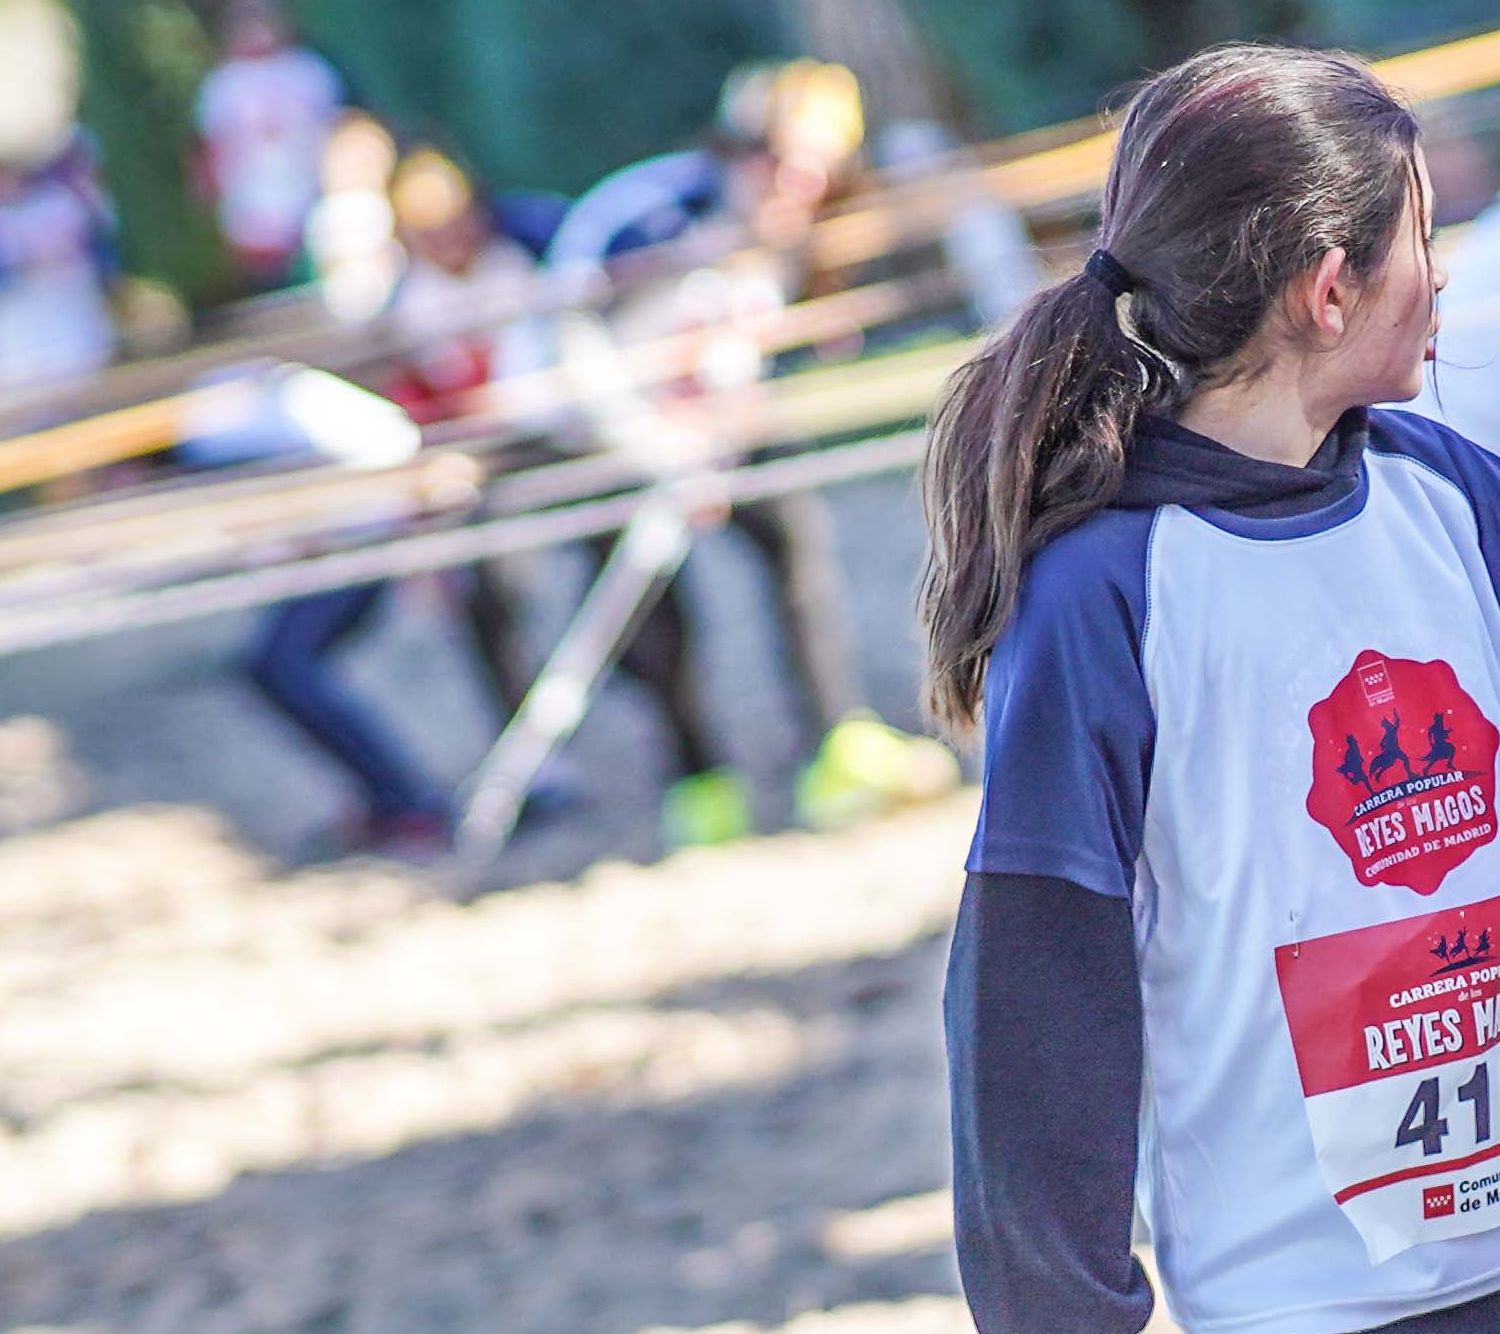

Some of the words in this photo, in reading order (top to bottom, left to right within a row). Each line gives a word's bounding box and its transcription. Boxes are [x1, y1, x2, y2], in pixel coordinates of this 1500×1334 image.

[1354, 786, 1404, 816] CARRERA
[1406, 770, 1464, 794] POPULAR
[1411, 785, 1486, 836] MAGOS
[1423, 840, 1441, 854] DE
[1444, 823, 1492, 847] MADRID
[1389, 975, 1468, 1008] CARRERA
[1364, 1008, 1464, 1071] REYES
[1460, 1198, 1481, 1213] de
